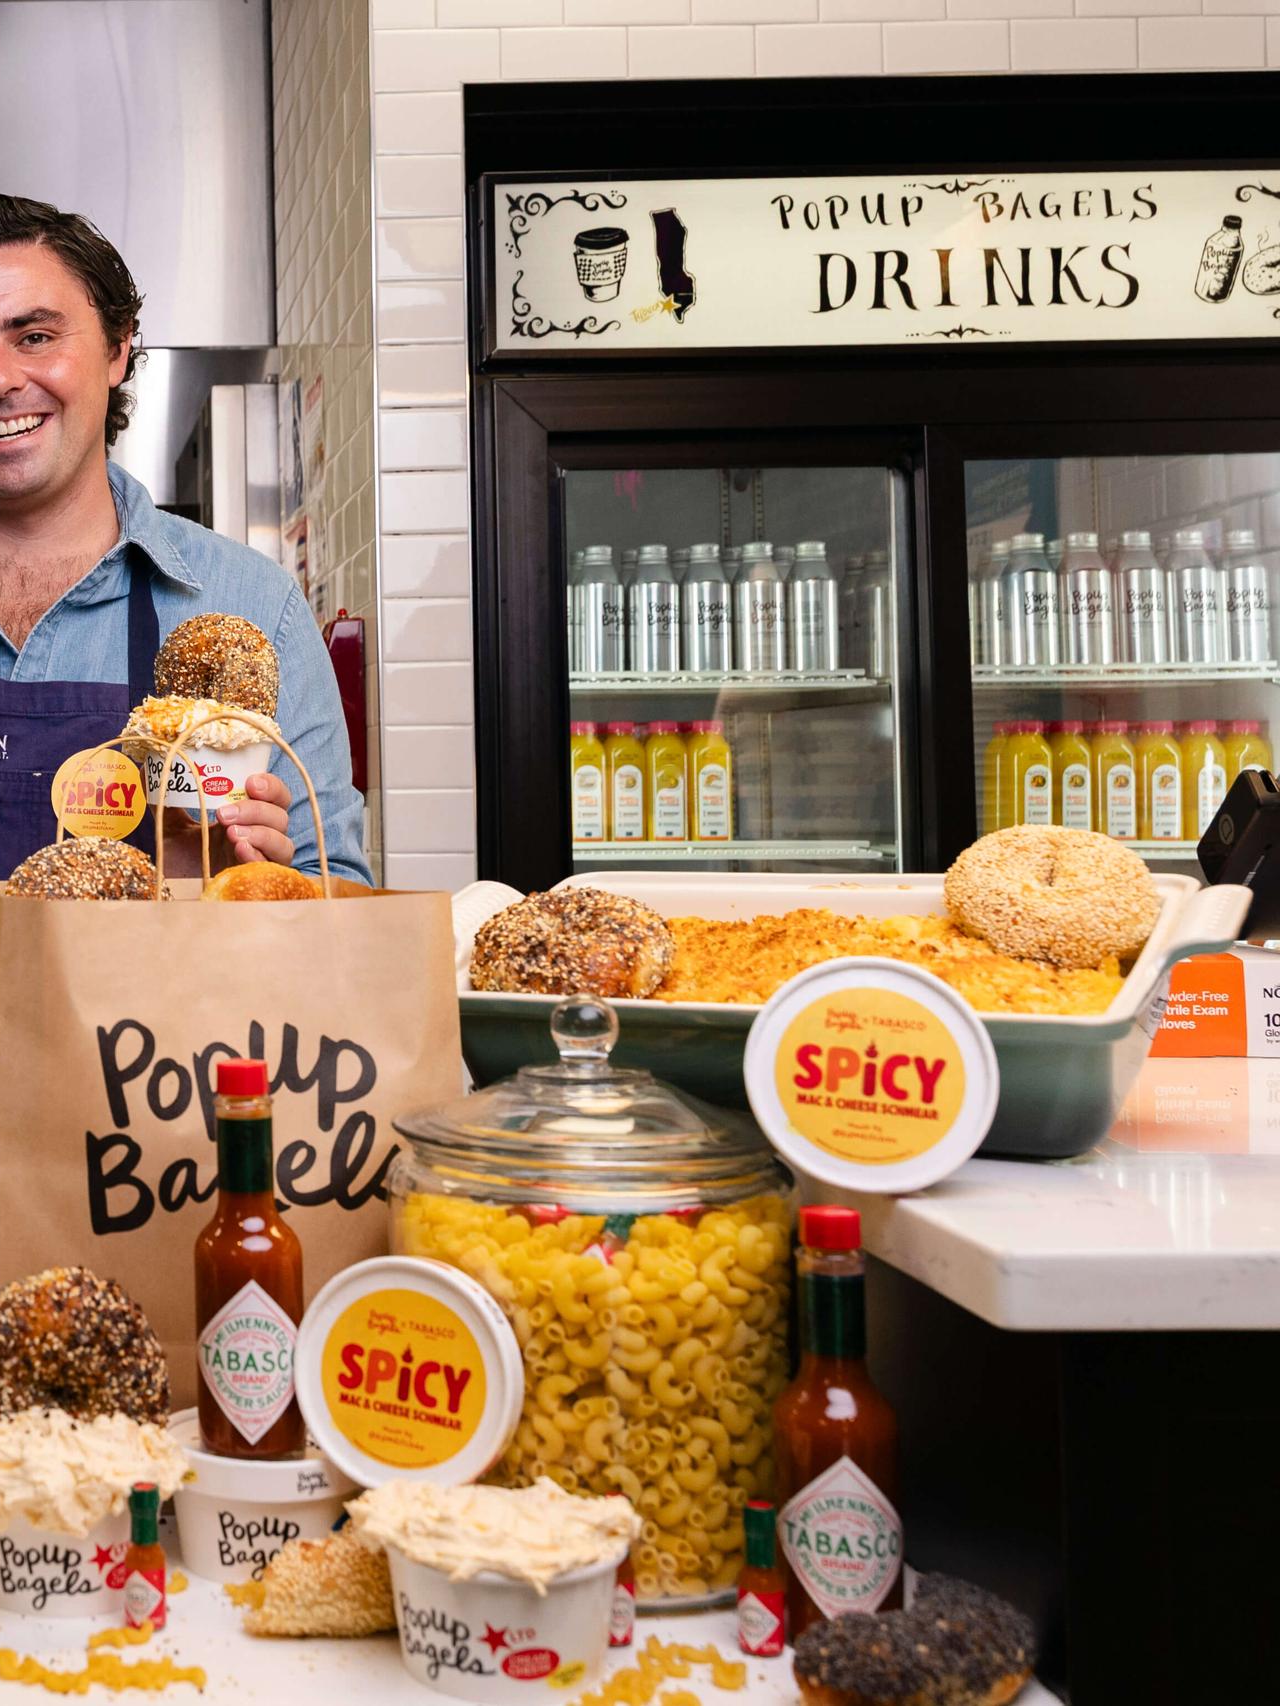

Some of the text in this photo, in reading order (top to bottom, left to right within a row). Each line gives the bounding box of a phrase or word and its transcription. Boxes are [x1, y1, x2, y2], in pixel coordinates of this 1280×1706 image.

[771, 183, 1158, 230] POPUP BAGELS
[808, 241, 1140, 314] DRINKS
[148, 757, 222, 779] Popp LTD
[148, 776, 199, 792] Baels
[205, 780, 228, 788] CREAM
[83, 808, 105, 816] CHEESE
[106, 809, 134, 817] SCHMEAR
[1167, 991, 1229, 1002] wder-Free
[1160, 1018, 1196, 1030] loves
[1166, 1005, 1190, 1016] trile
[1193, 1005, 1229, 1016] Exam
[796, 1093, 821, 1106] MAC
[835, 1097, 878, 1115] CHEESE
[881, 1103, 939, 1120] SCHMEAR
[86, 1110, 402, 1236] Bael
[202, 1343, 295, 1372] TABASC
[214, 1371, 290, 1409] PEPPER SAUCE
[231, 1374, 272, 1385] BRAND
[339, 1393, 361, 1409] MAC
[373, 1401, 411, 1420] CHEESE
[413, 1410, 463, 1431] SCHMEAR
[785, 1520, 900, 1560] TABASCO
[218, 1539, 281, 1582] Bag
[821, 1557, 866, 1572] BRAND
[0, 1565, 102, 1610] Bagels
